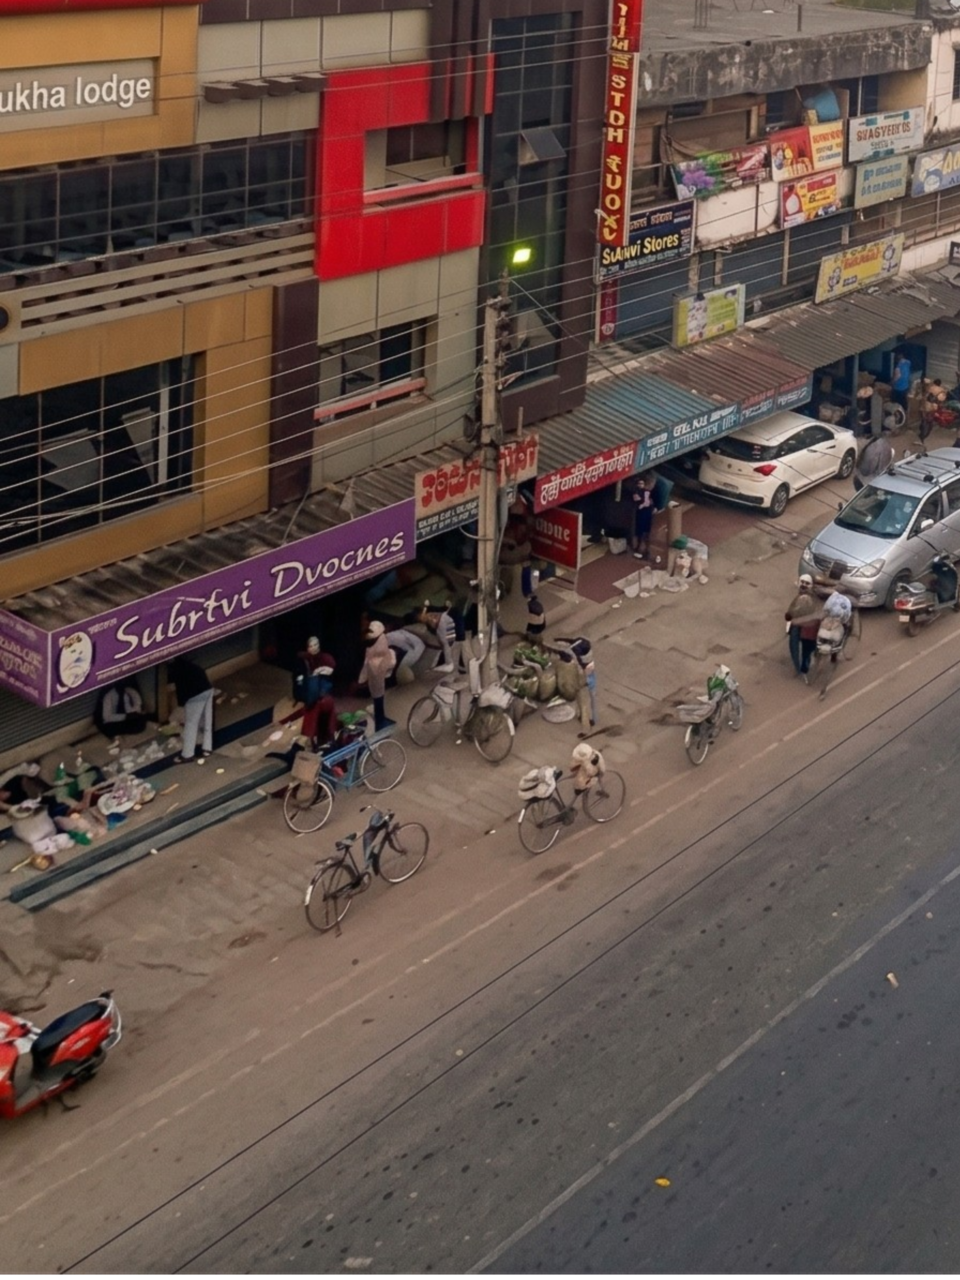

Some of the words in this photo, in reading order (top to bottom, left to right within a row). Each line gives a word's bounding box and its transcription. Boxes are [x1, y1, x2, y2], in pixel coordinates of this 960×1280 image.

[0, 81, 66, 113] ukha
[76, 73, 151, 109] lodge
[643, 233, 680, 255] Stores
